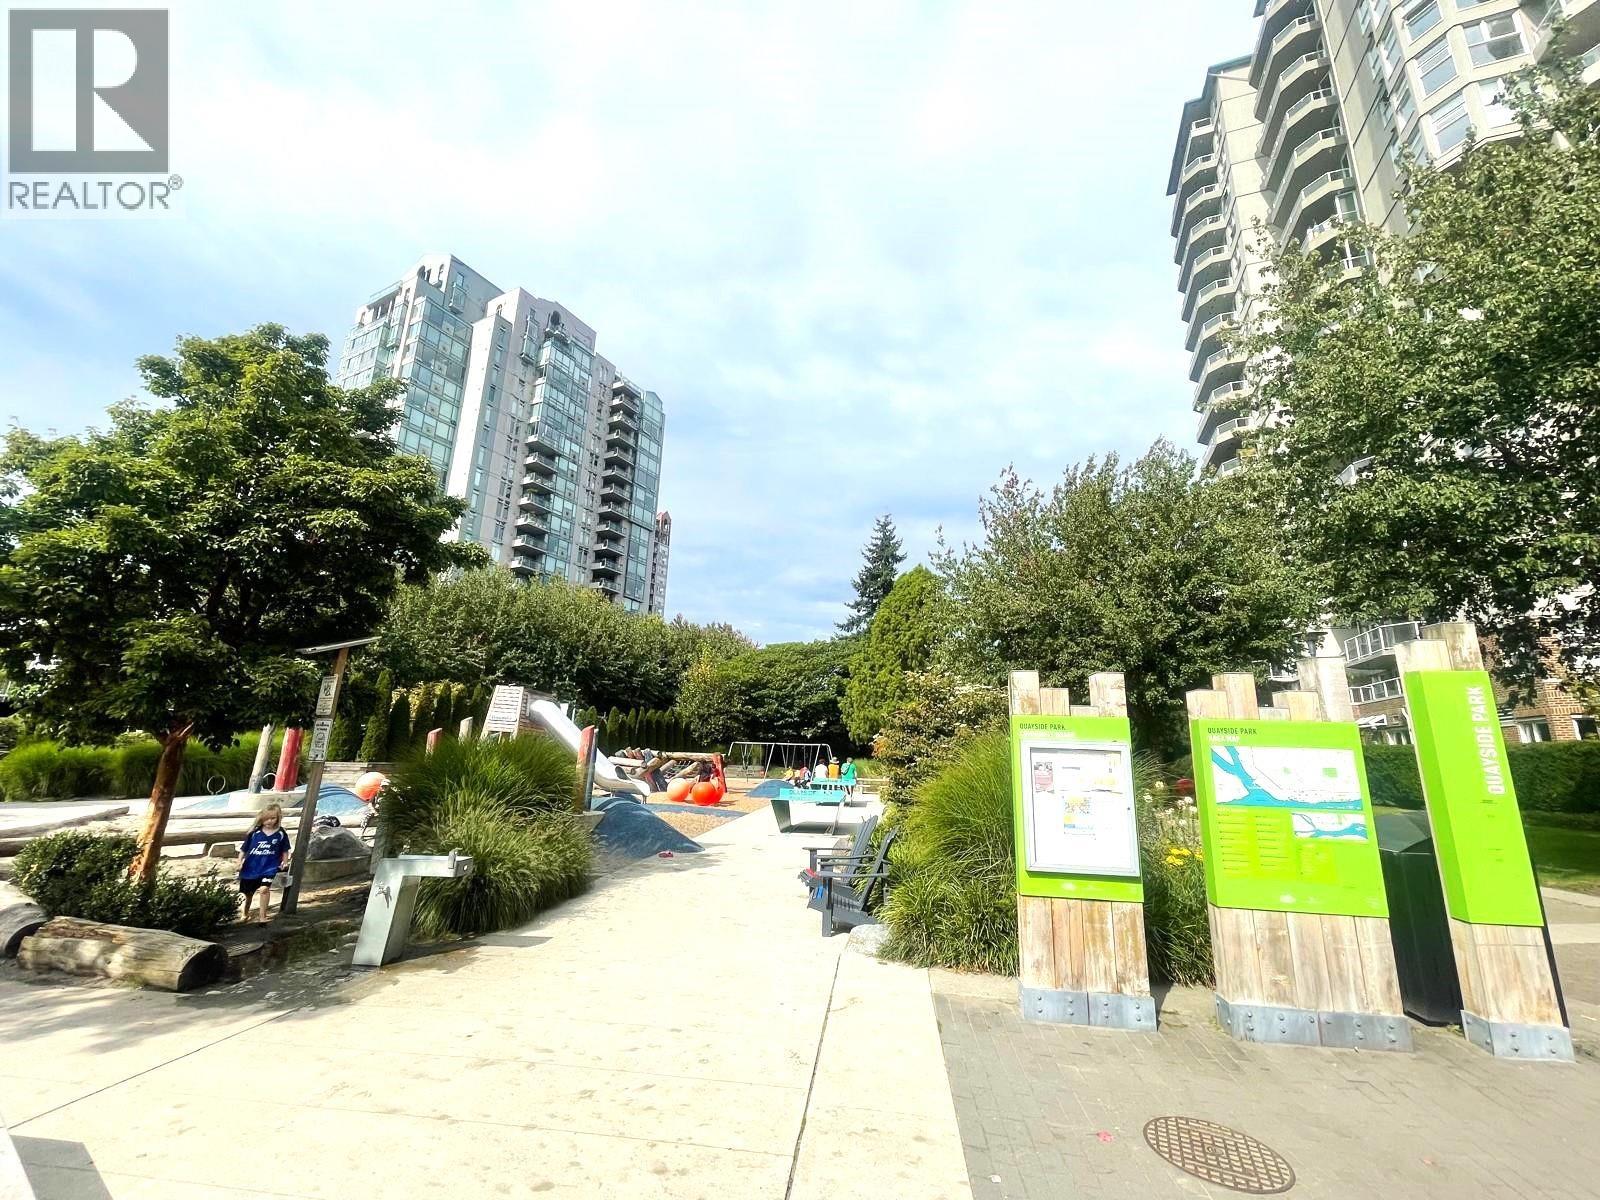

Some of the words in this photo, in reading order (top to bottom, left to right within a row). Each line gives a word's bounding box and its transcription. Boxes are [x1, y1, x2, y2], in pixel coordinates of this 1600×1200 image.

[1467, 685, 1490, 723] PARK
[1019, 722, 1048, 730] QUAYSIDE
[1049, 723, 1066, 731] PARK
[1207, 727, 1239, 735] QUAYSIDE
[1240, 728, 1258, 736] PARK
[1473, 728, 1506, 795] QUAYSIDE
[257, 840, 271, 849] Tim
